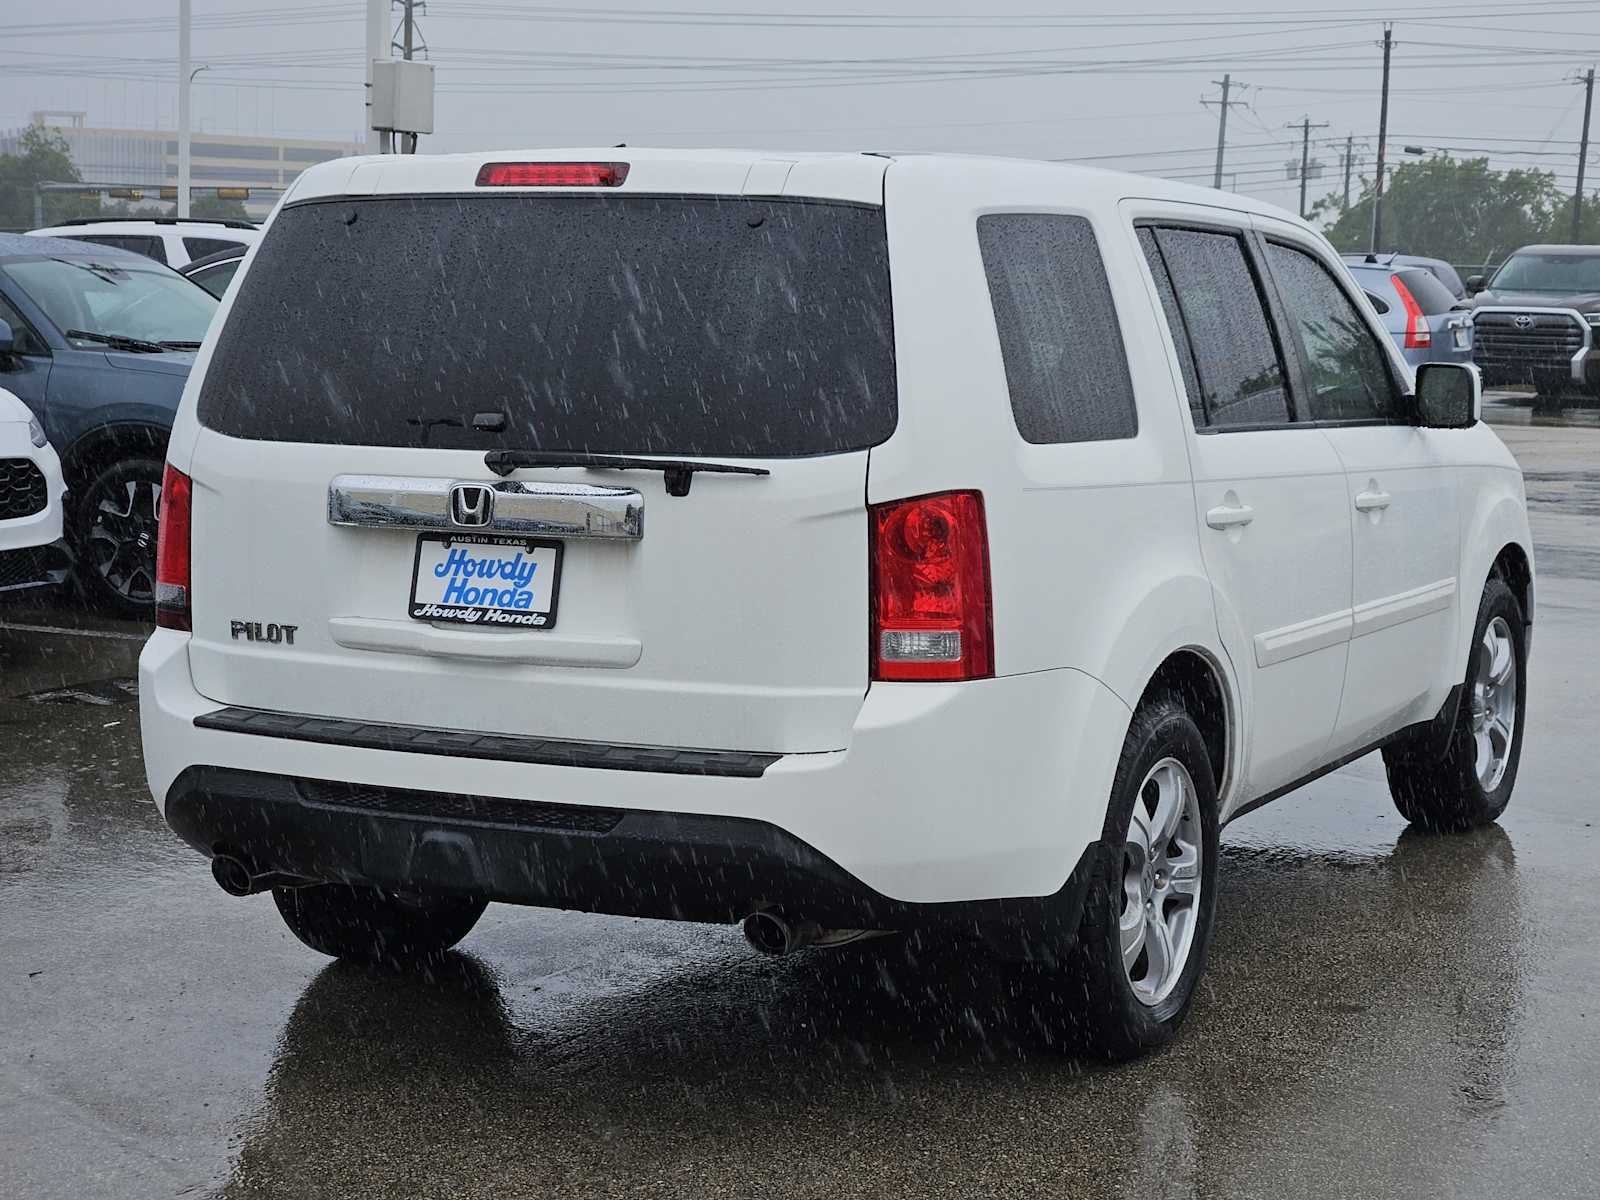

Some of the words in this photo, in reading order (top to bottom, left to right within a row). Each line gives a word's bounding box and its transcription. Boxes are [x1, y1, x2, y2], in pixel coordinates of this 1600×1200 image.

[450, 535, 488, 544] AUSTIN
[493, 537, 527, 546] TEXAS
[434, 548, 537, 588] Howdy
[442, 577, 534, 609] Honda
[414, 604, 482, 622] Howdy
[483, 609, 547, 626] Honda
[230, 620, 298, 645] PILOT
